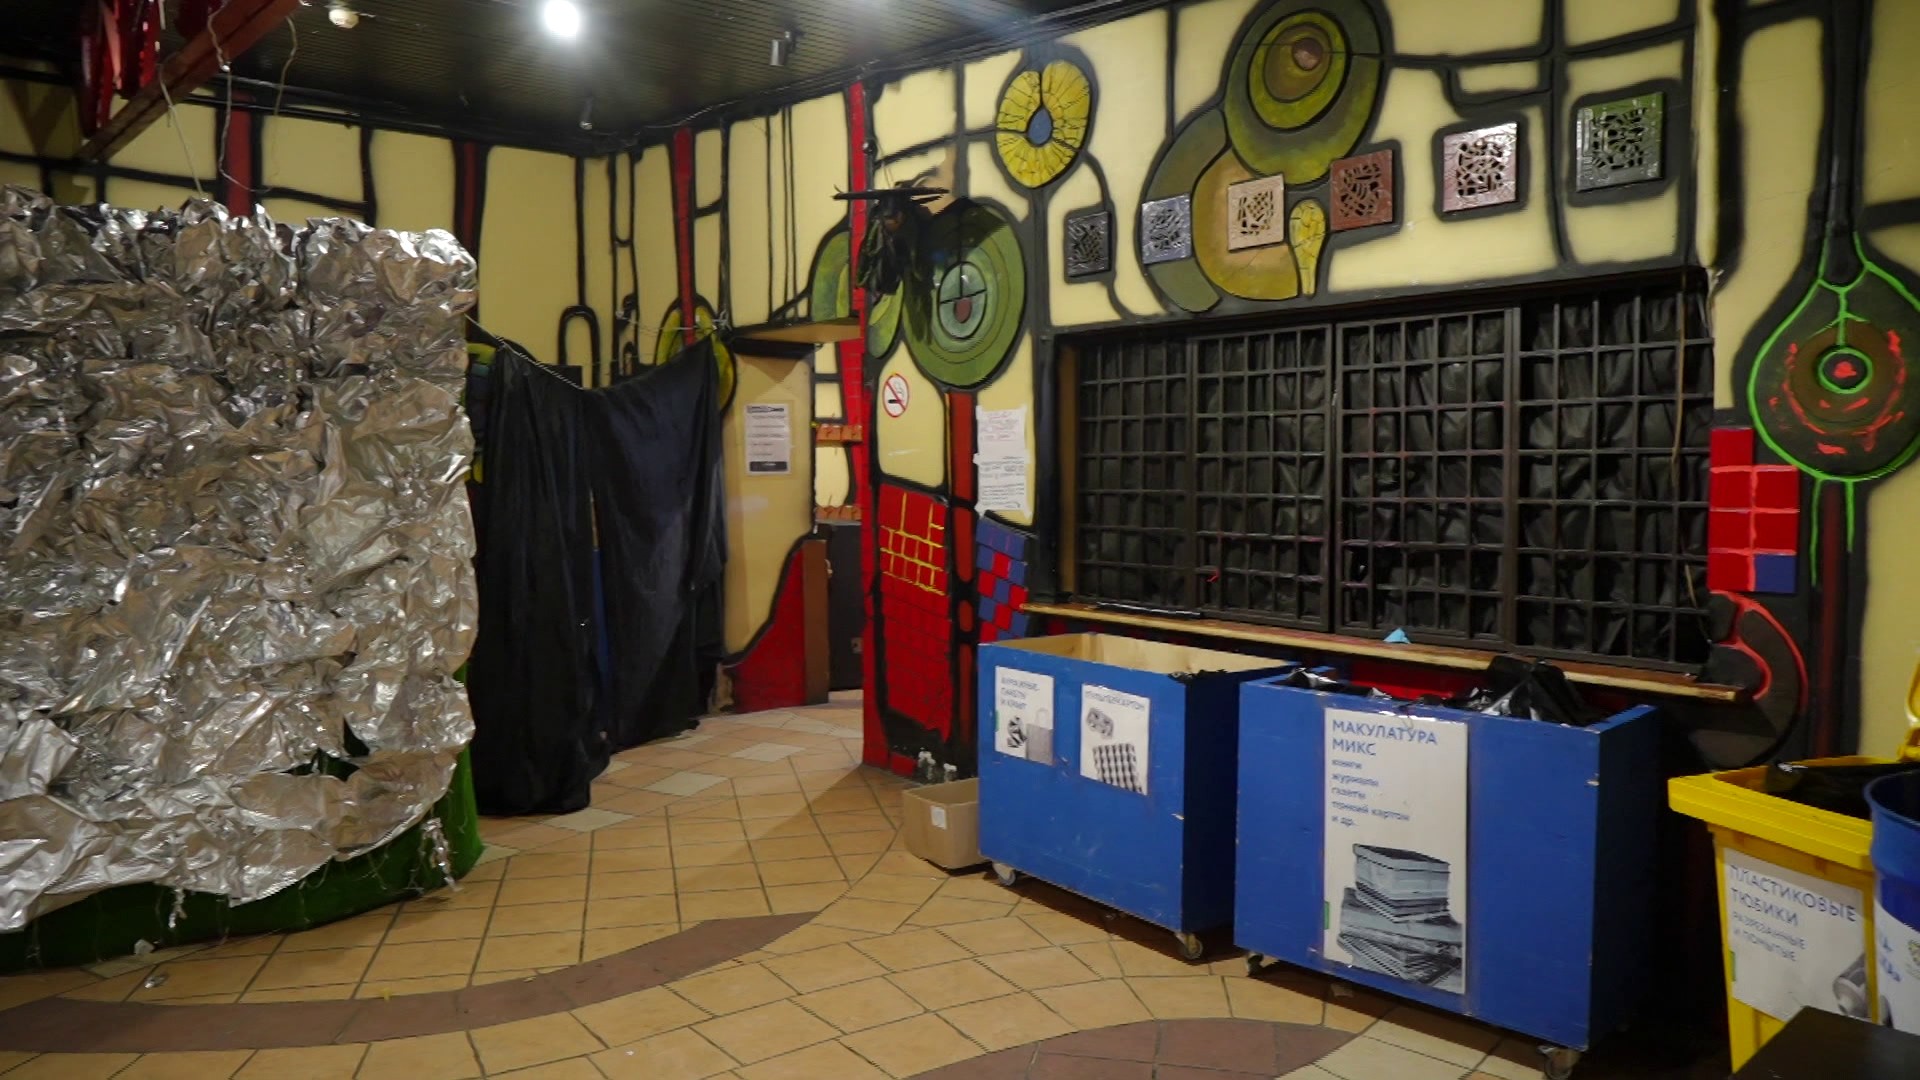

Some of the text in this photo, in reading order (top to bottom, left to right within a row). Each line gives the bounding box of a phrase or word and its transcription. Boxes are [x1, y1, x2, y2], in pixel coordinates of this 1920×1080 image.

[1332, 719, 1438, 745] МАКУЛАТУРА
[1332, 738, 1377, 756] МИКС
[1332, 759, 1362, 769] книги
[1332, 773, 1379, 787] журналы
[1331, 787, 1366, 799] газеты
[1371, 809, 1410, 821] картон
[1730, 864, 1857, 923] ПЛАСТИКОВЫЕ
[1731, 887, 1799, 927] ТЮБИКИ
